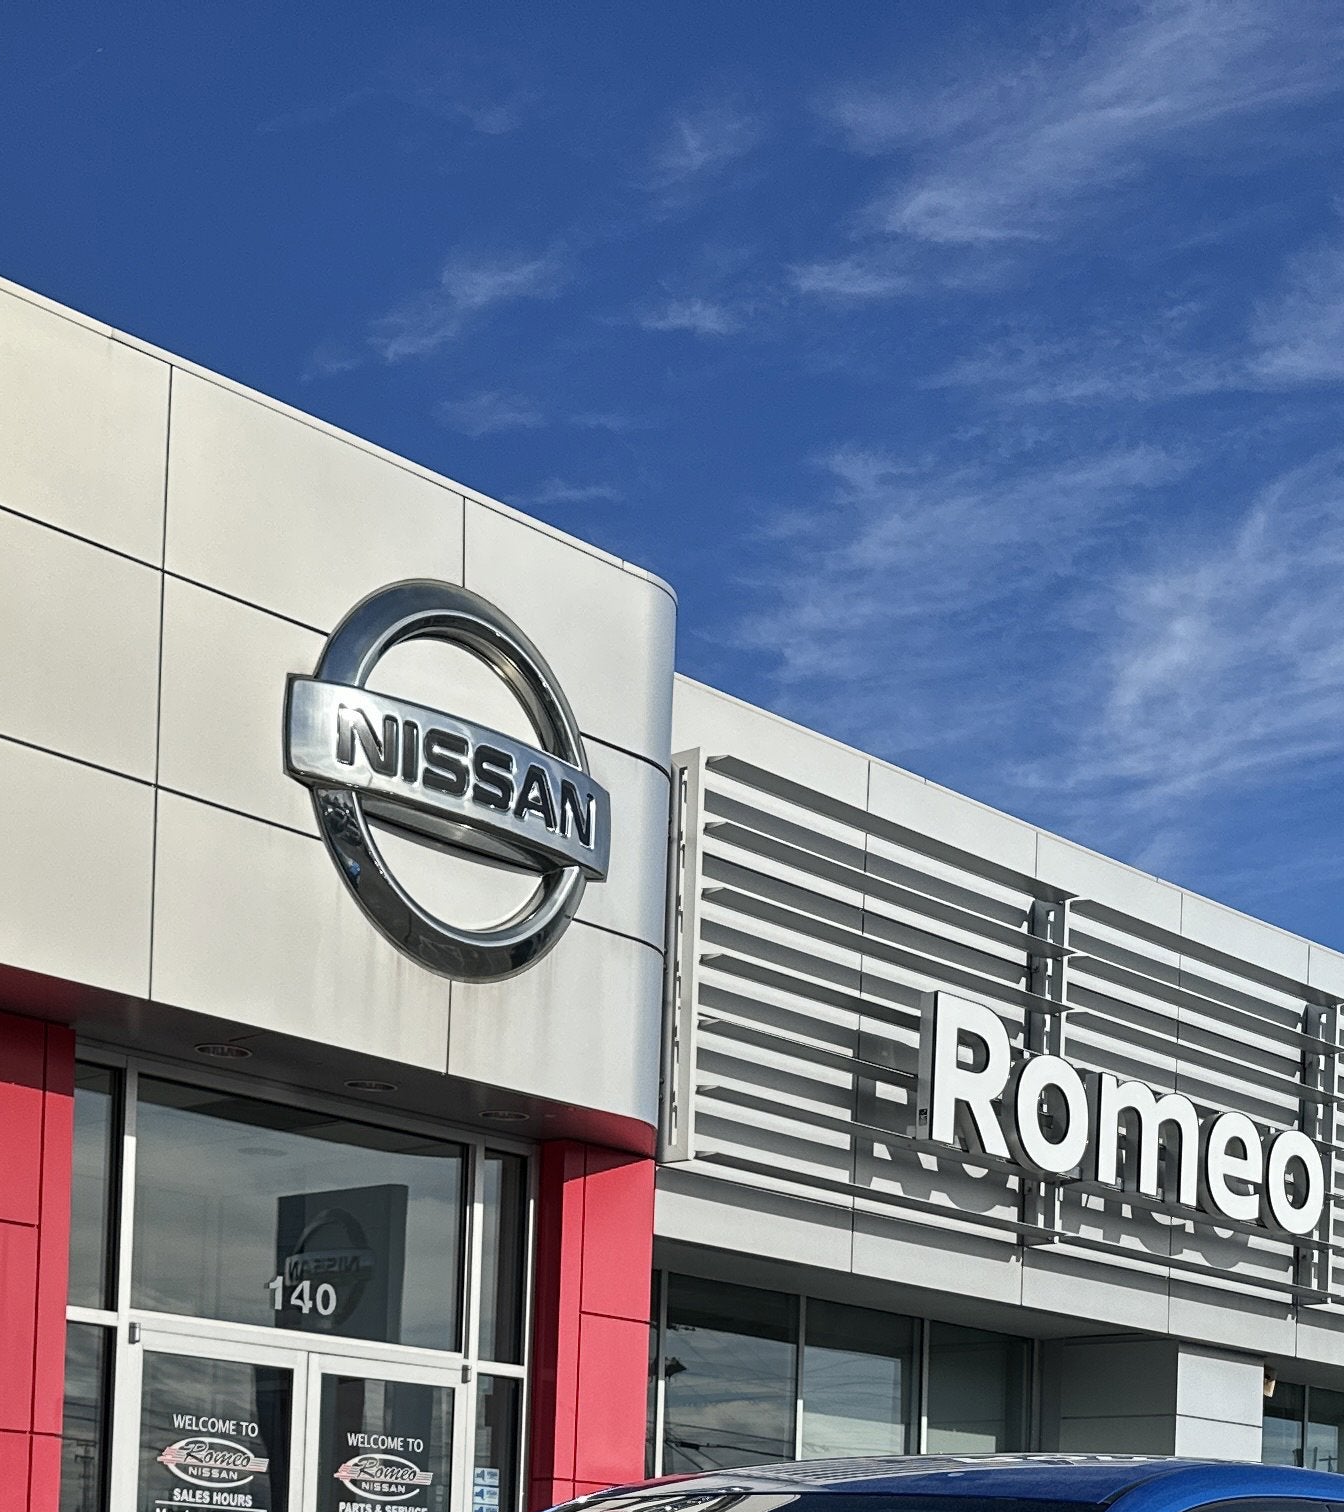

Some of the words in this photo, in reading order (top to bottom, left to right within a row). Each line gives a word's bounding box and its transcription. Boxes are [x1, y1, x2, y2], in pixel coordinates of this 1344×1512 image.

[335, 702, 596, 850] NISSAN
[921, 990, 1324, 1236] Romeo
[269, 1275, 337, 1316] 140
[173, 1413, 237, 1435] WELCOME
[240, 1421, 258, 1437] TO
[179, 1440, 252, 1467] Romeo
[347, 1432, 404, 1451] WELCOME
[407, 1438, 424, 1452] TO
[188, 1466, 238, 1480] NISSAN
[353, 1457, 417, 1480] Romeo
[173, 1488, 210, 1504] SALES
[212, 1492, 253, 1507] HOURS
[361, 1481, 406, 1494] NISSAN
